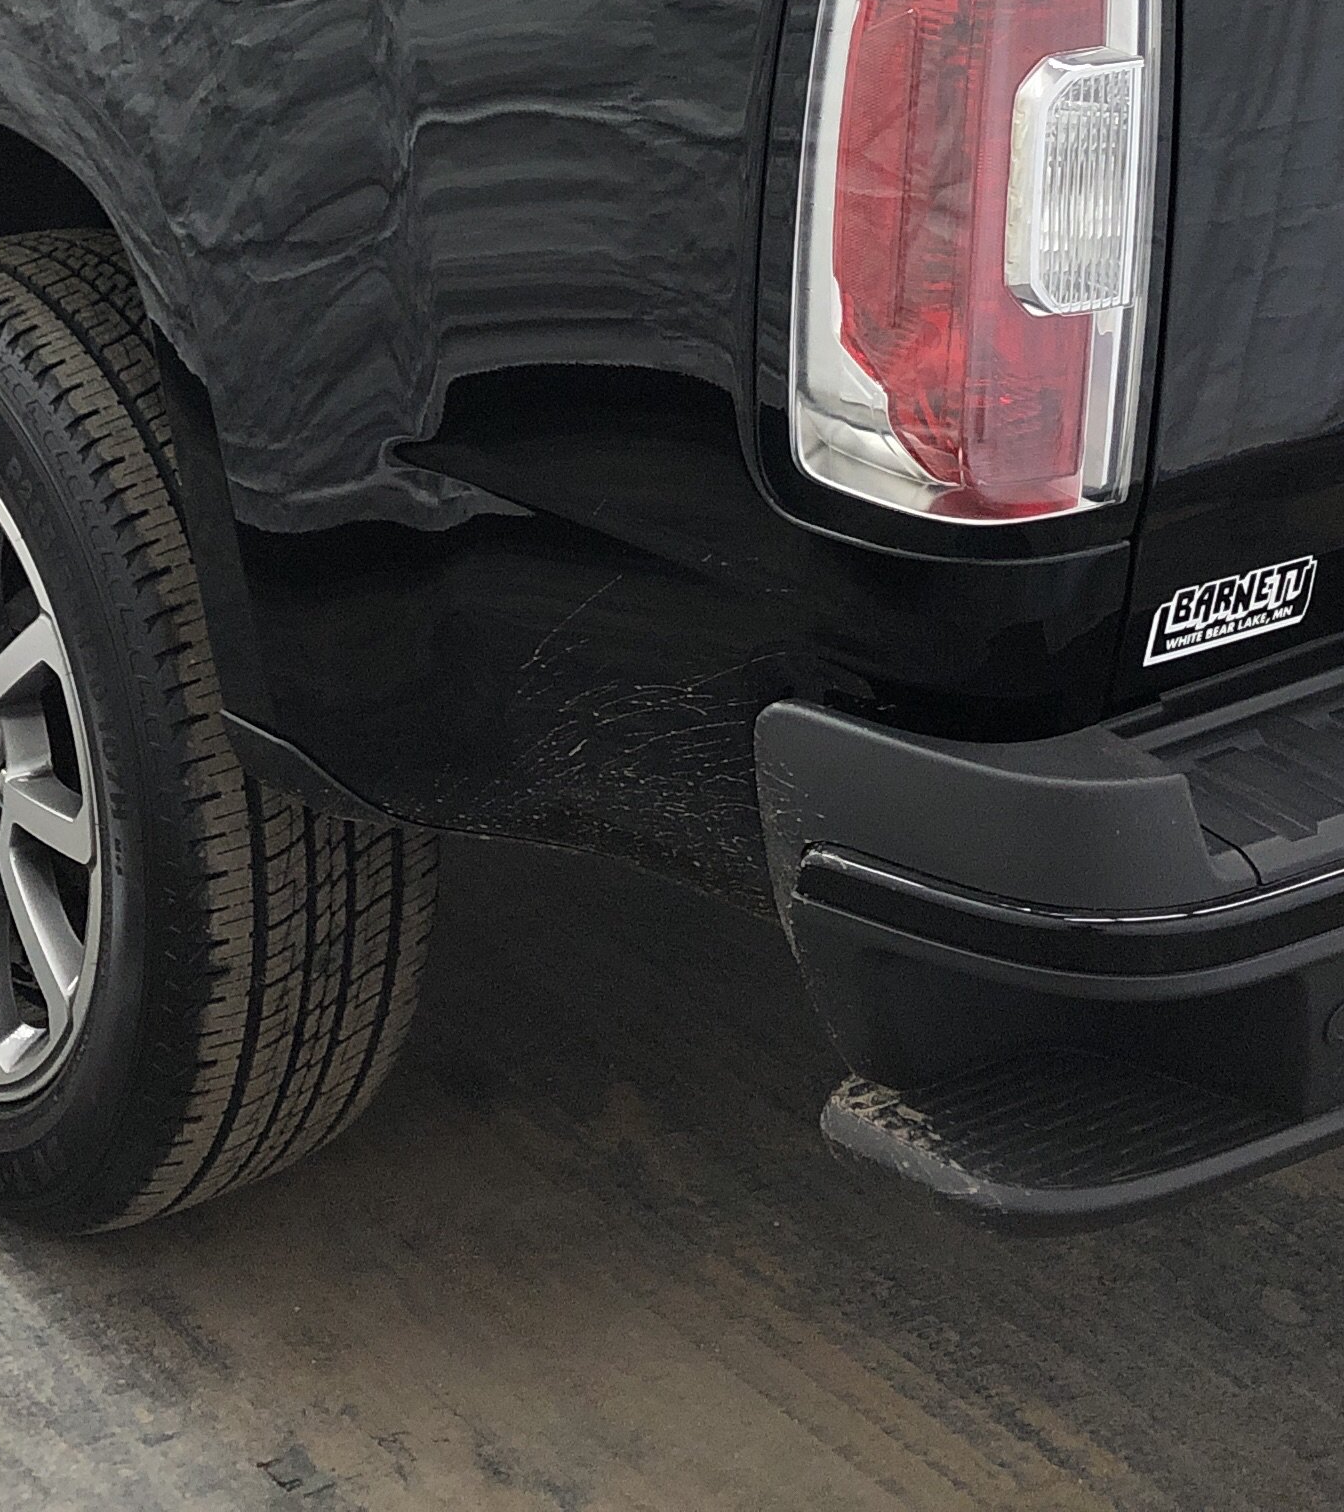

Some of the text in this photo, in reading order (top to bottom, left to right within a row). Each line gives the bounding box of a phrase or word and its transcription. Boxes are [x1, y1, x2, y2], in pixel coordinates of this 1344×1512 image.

[1164, 555, 1313, 634] BARNETT
[1165, 605, 1294, 650] WHITE BEAR LAKE, MN
